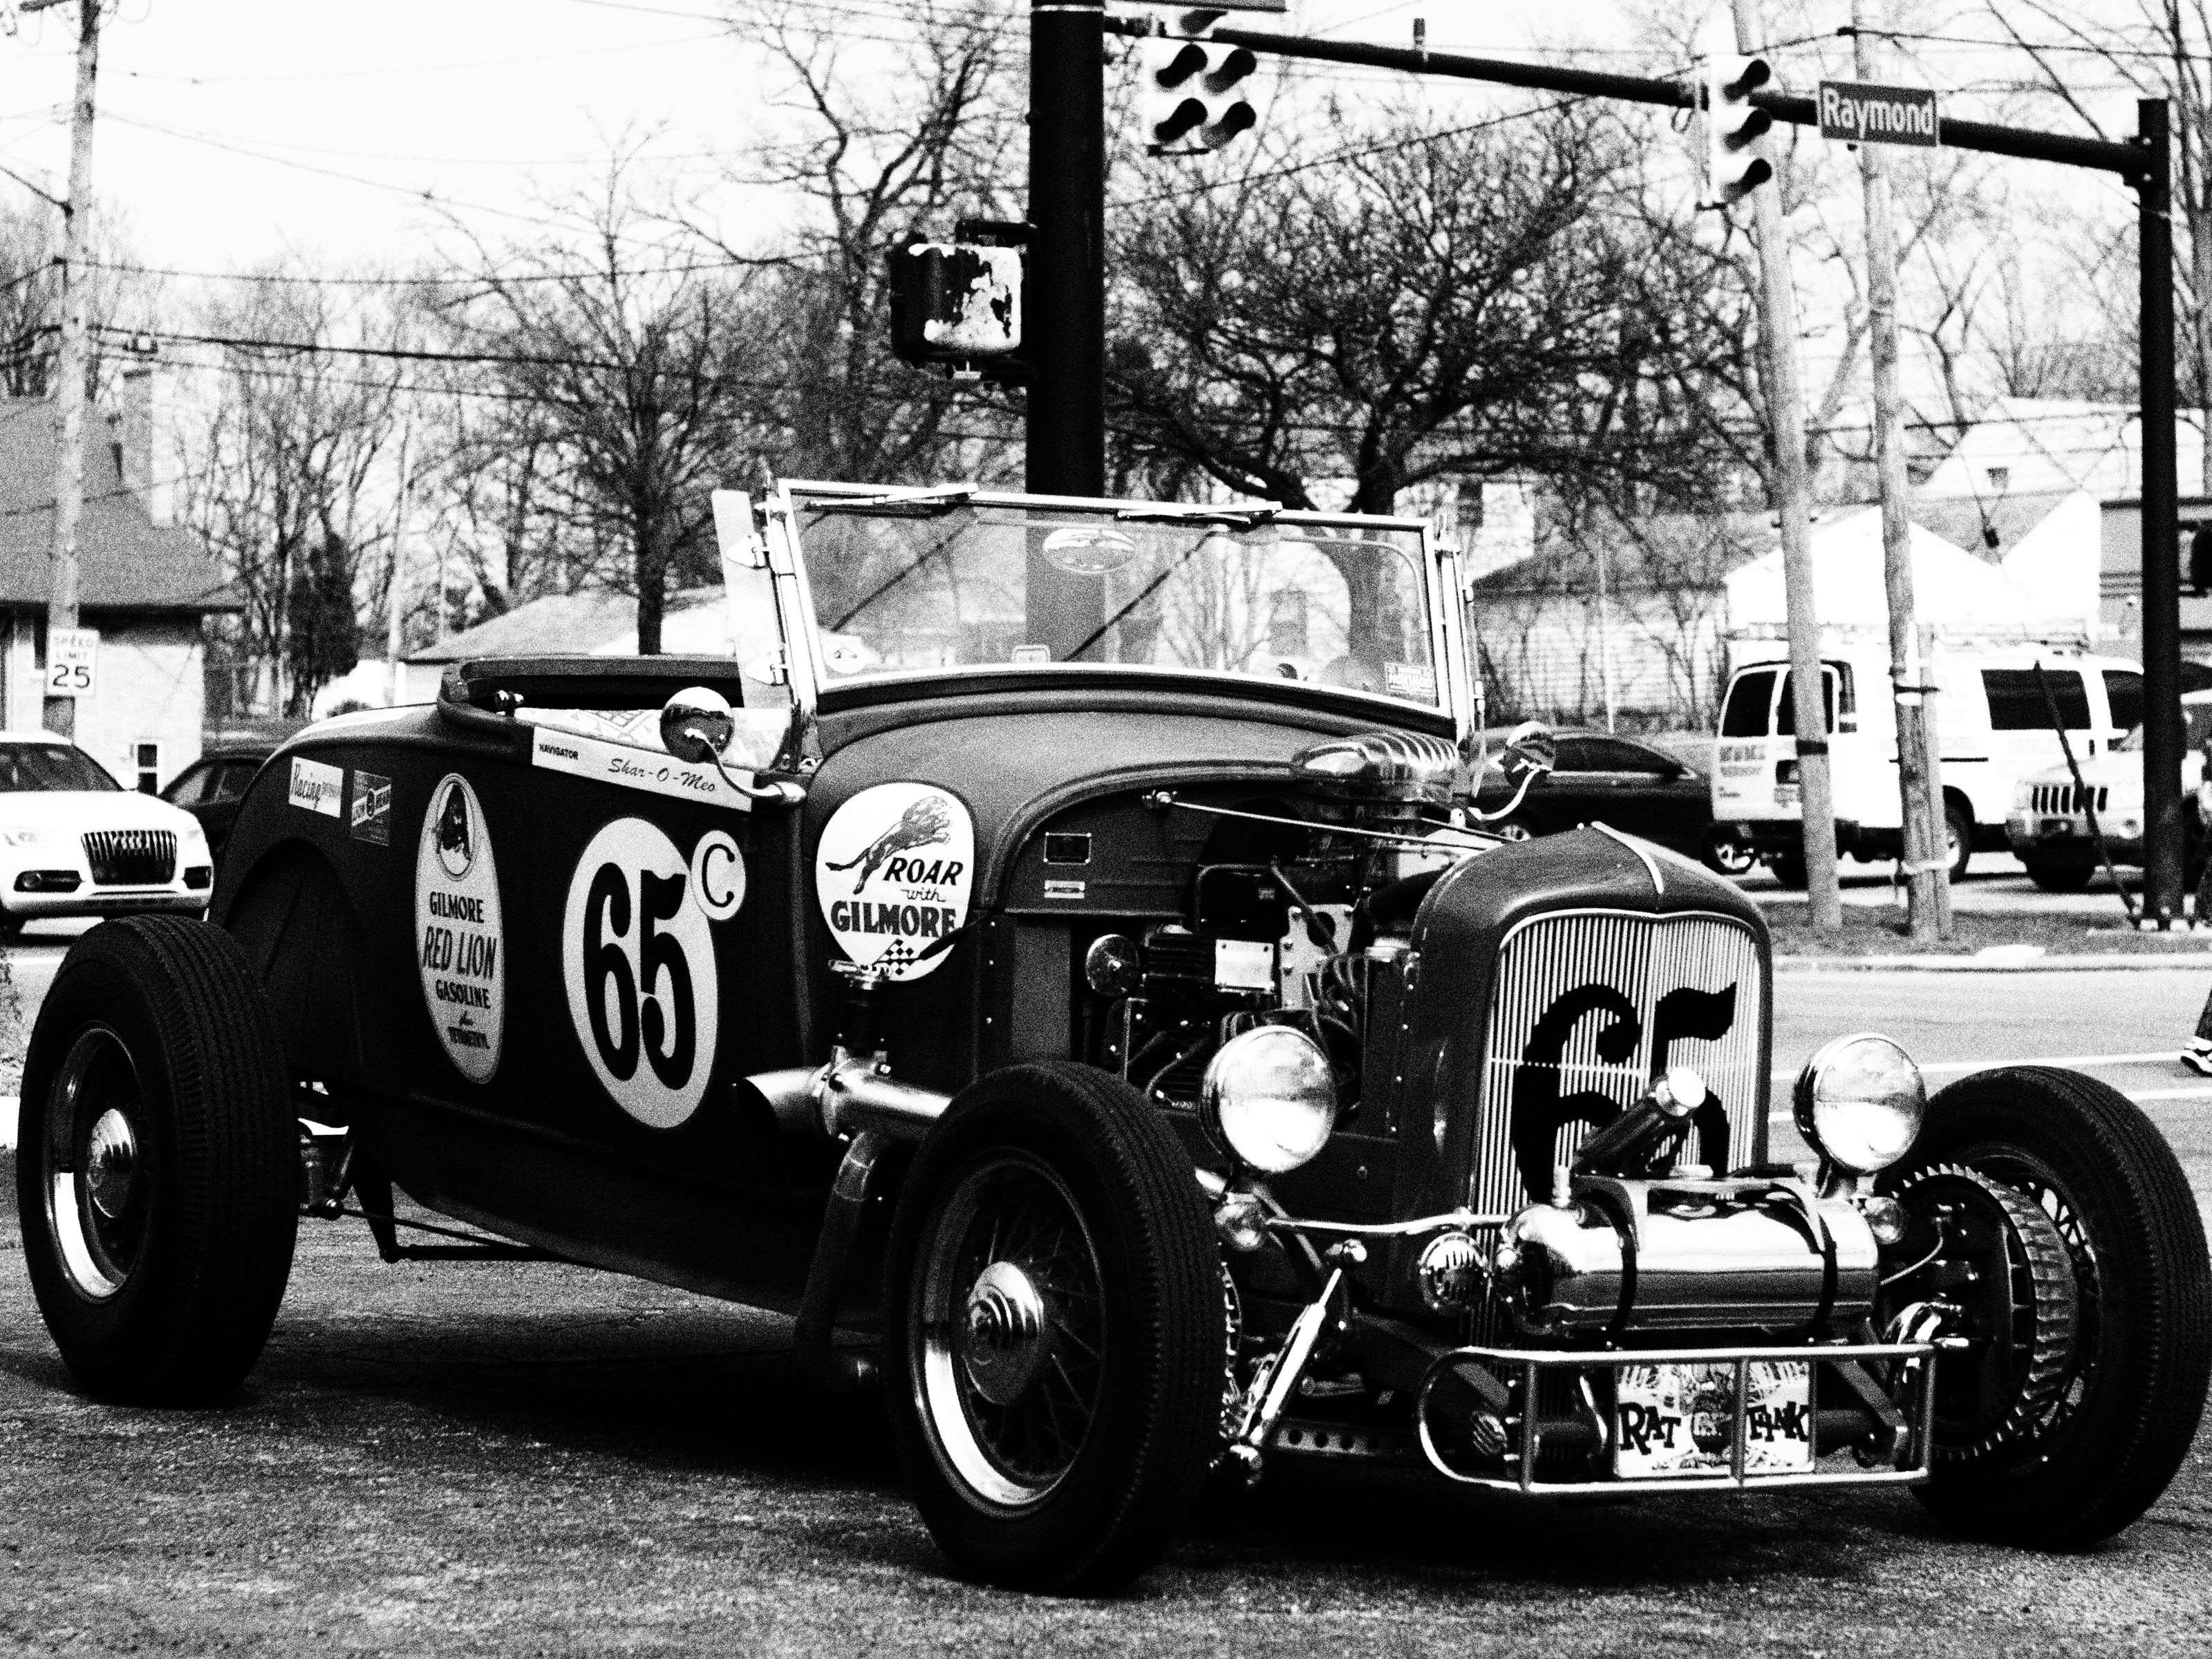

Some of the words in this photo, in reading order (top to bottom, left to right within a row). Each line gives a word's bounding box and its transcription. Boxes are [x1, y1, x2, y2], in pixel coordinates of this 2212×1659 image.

[1823, 88, 1934, 139] Raymond
[53, 635, 94, 648] SPEED
[56, 651, 88, 660] LIMIT
[53, 664, 91, 689] 25
[538, 743, 579, 760] NAVIGATOR
[702, 843, 735, 908] C
[883, 856, 964, 886] ROAR
[429, 891, 484, 924] GILMORE
[900, 887, 947, 903] with
[830, 900, 957, 937] GILMORE
[422, 926, 453, 972] RED
[457, 932, 497, 981] LION
[583, 861, 696, 1091] 65
[435, 979, 491, 1009] GASOLINE
[1617, 1402, 1681, 1456] RAT
